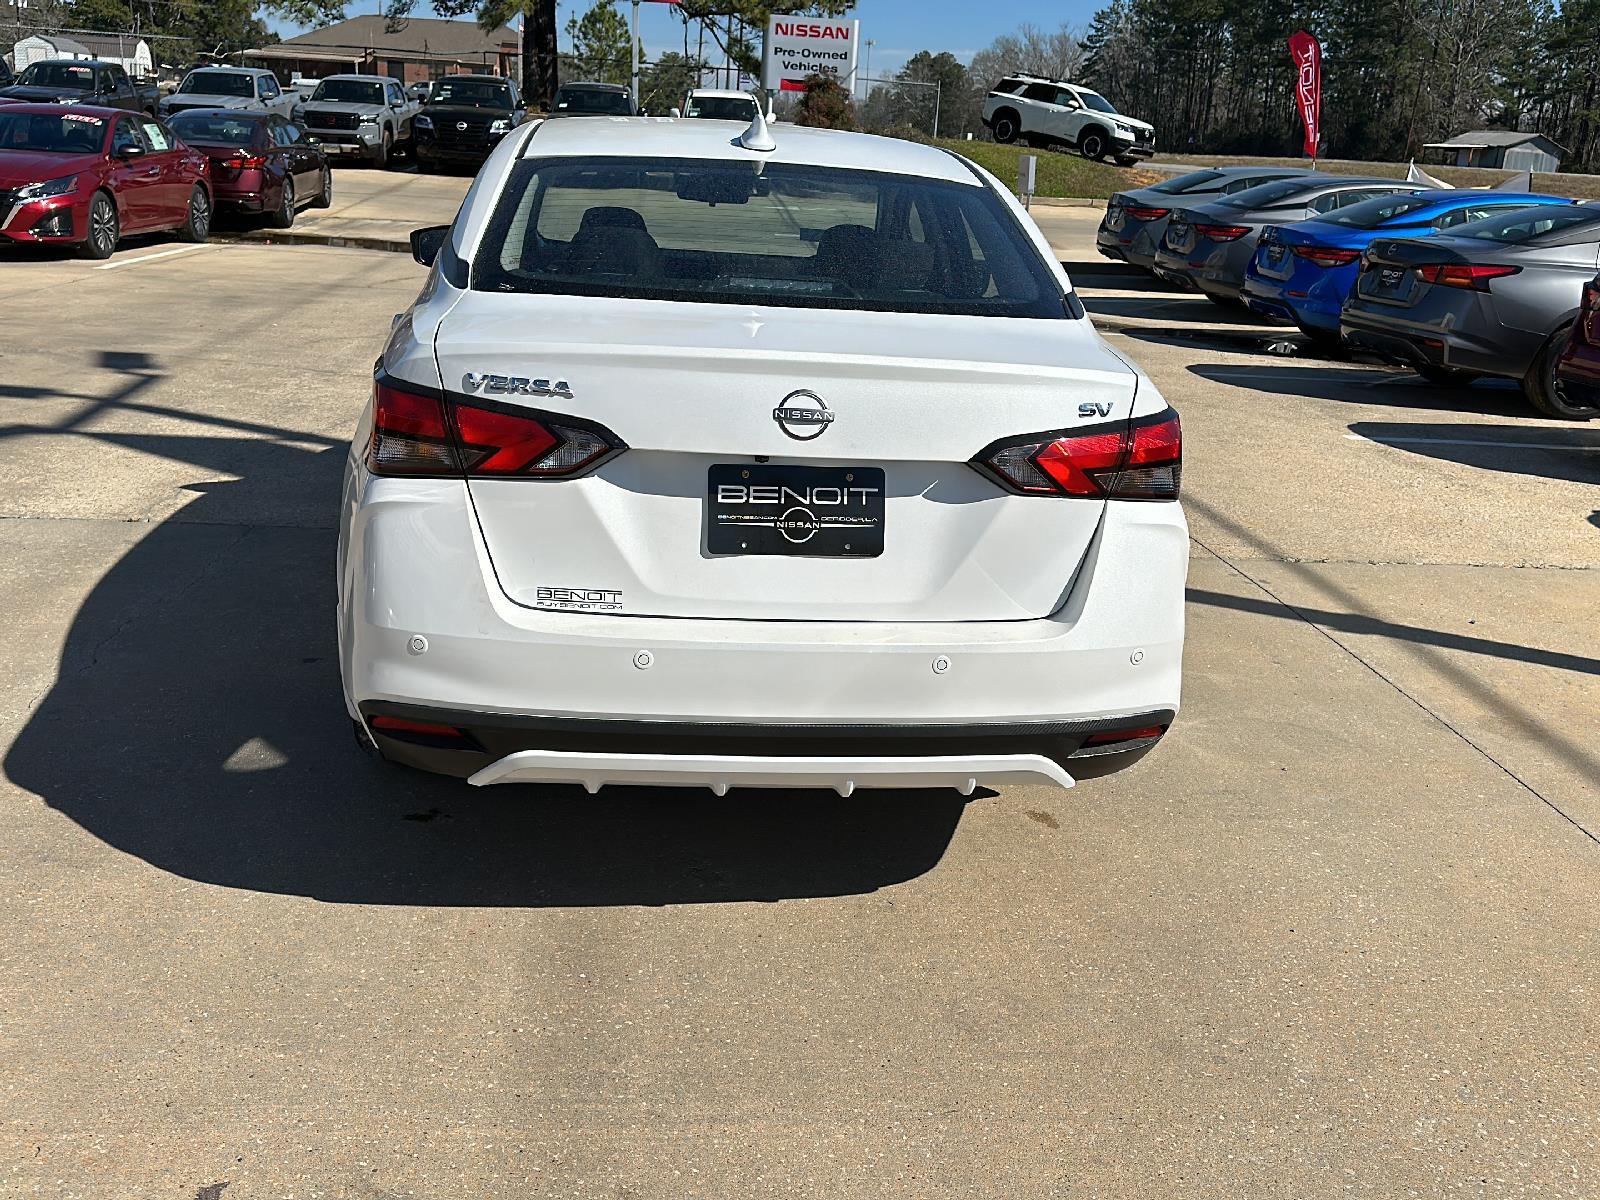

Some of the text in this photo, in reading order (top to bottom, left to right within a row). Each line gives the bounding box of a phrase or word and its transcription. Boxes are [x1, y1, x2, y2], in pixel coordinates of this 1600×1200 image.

[775, 22, 849, 40] NISSAN
[774, 46, 848, 60] Pre-Owned
[782, 60, 838, 73] Vehicles
[462, 372, 576, 399] VERSA
[774, 409, 834, 421] NISSAN
[1078, 402, 1114, 418] SV
[717, 484, 879, 506] BENOIT
[776, 521, 820, 529] NISSAN
[536, 588, 623, 602] BENOIT
